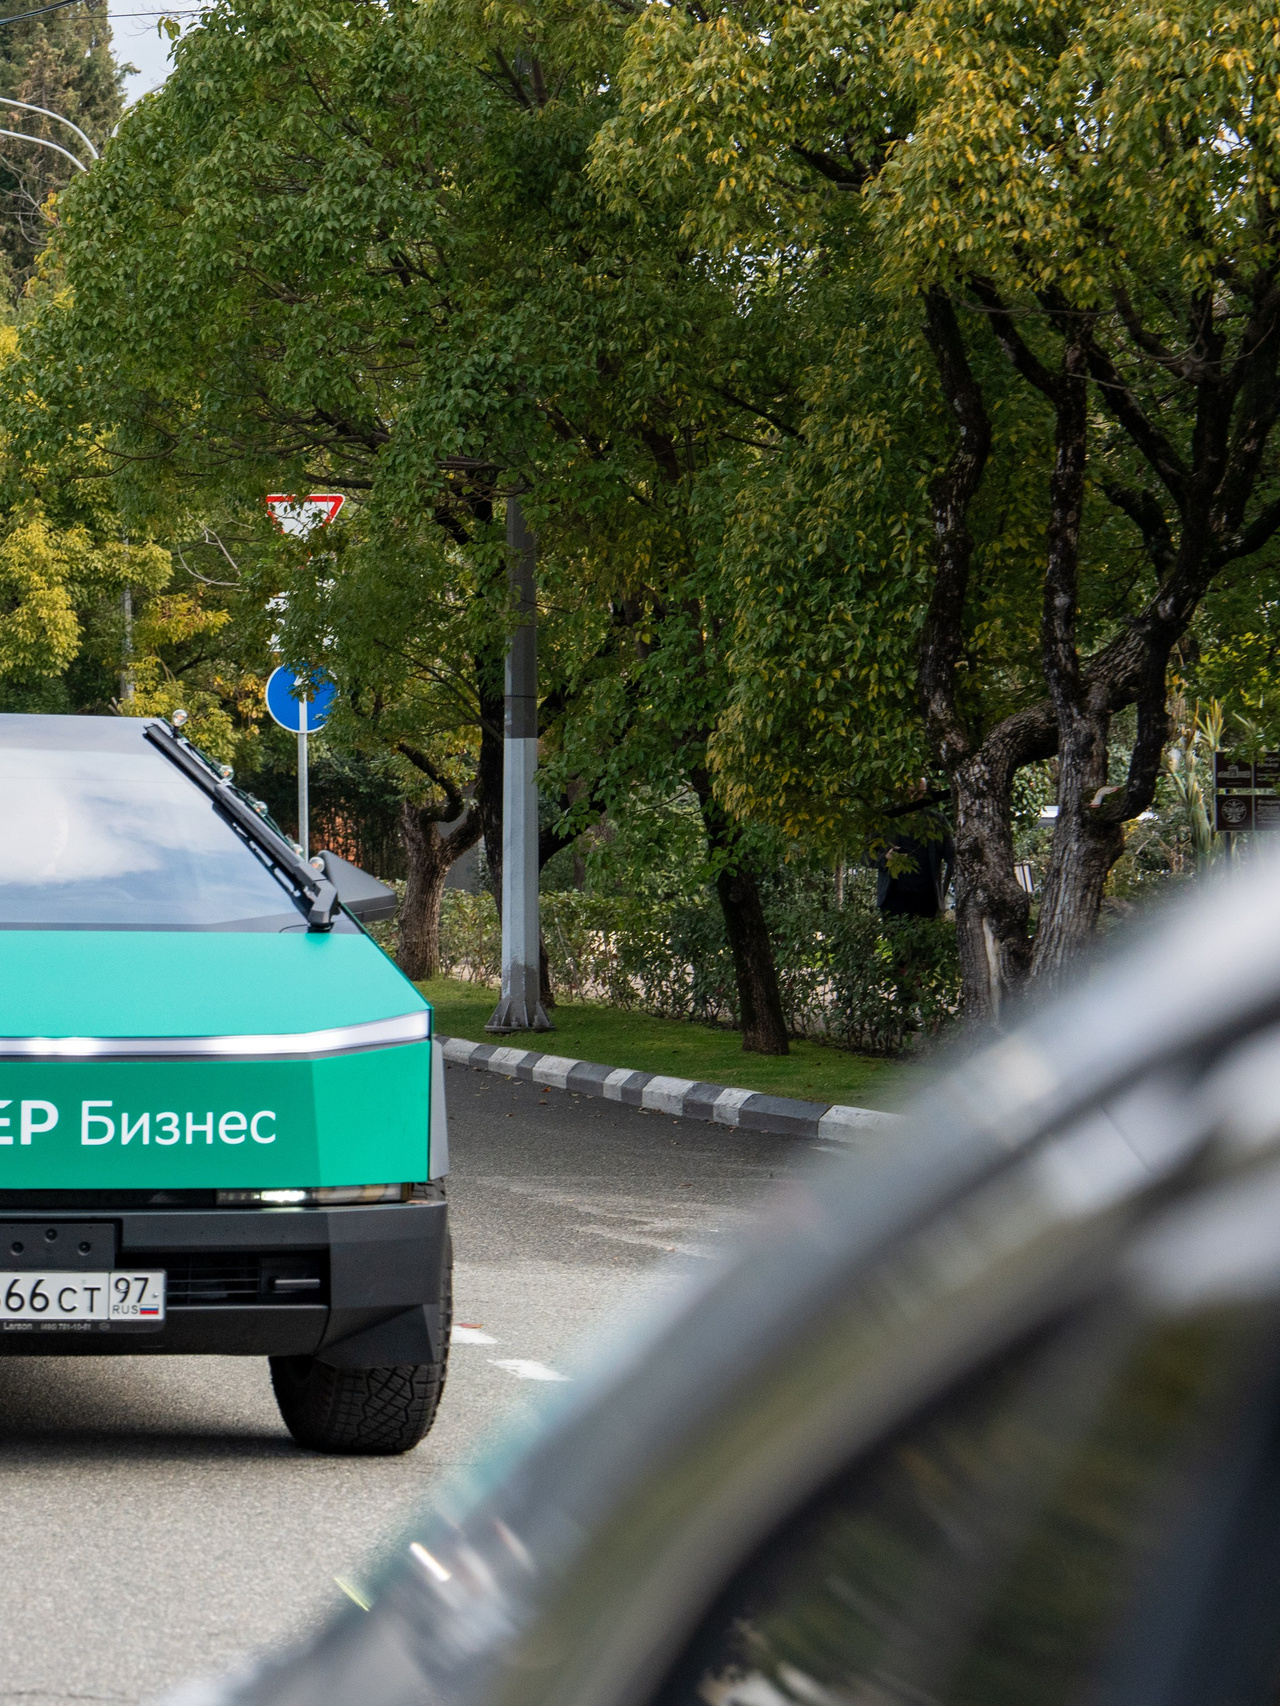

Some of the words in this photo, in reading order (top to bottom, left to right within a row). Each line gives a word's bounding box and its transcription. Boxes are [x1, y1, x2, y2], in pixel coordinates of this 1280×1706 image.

[80, 1100, 276, 1145] Бизнес
[115, 1277, 150, 1303] 97
[112, 1305, 138, 1314] RUS
[3, 1322, 32, 1331] Larson
